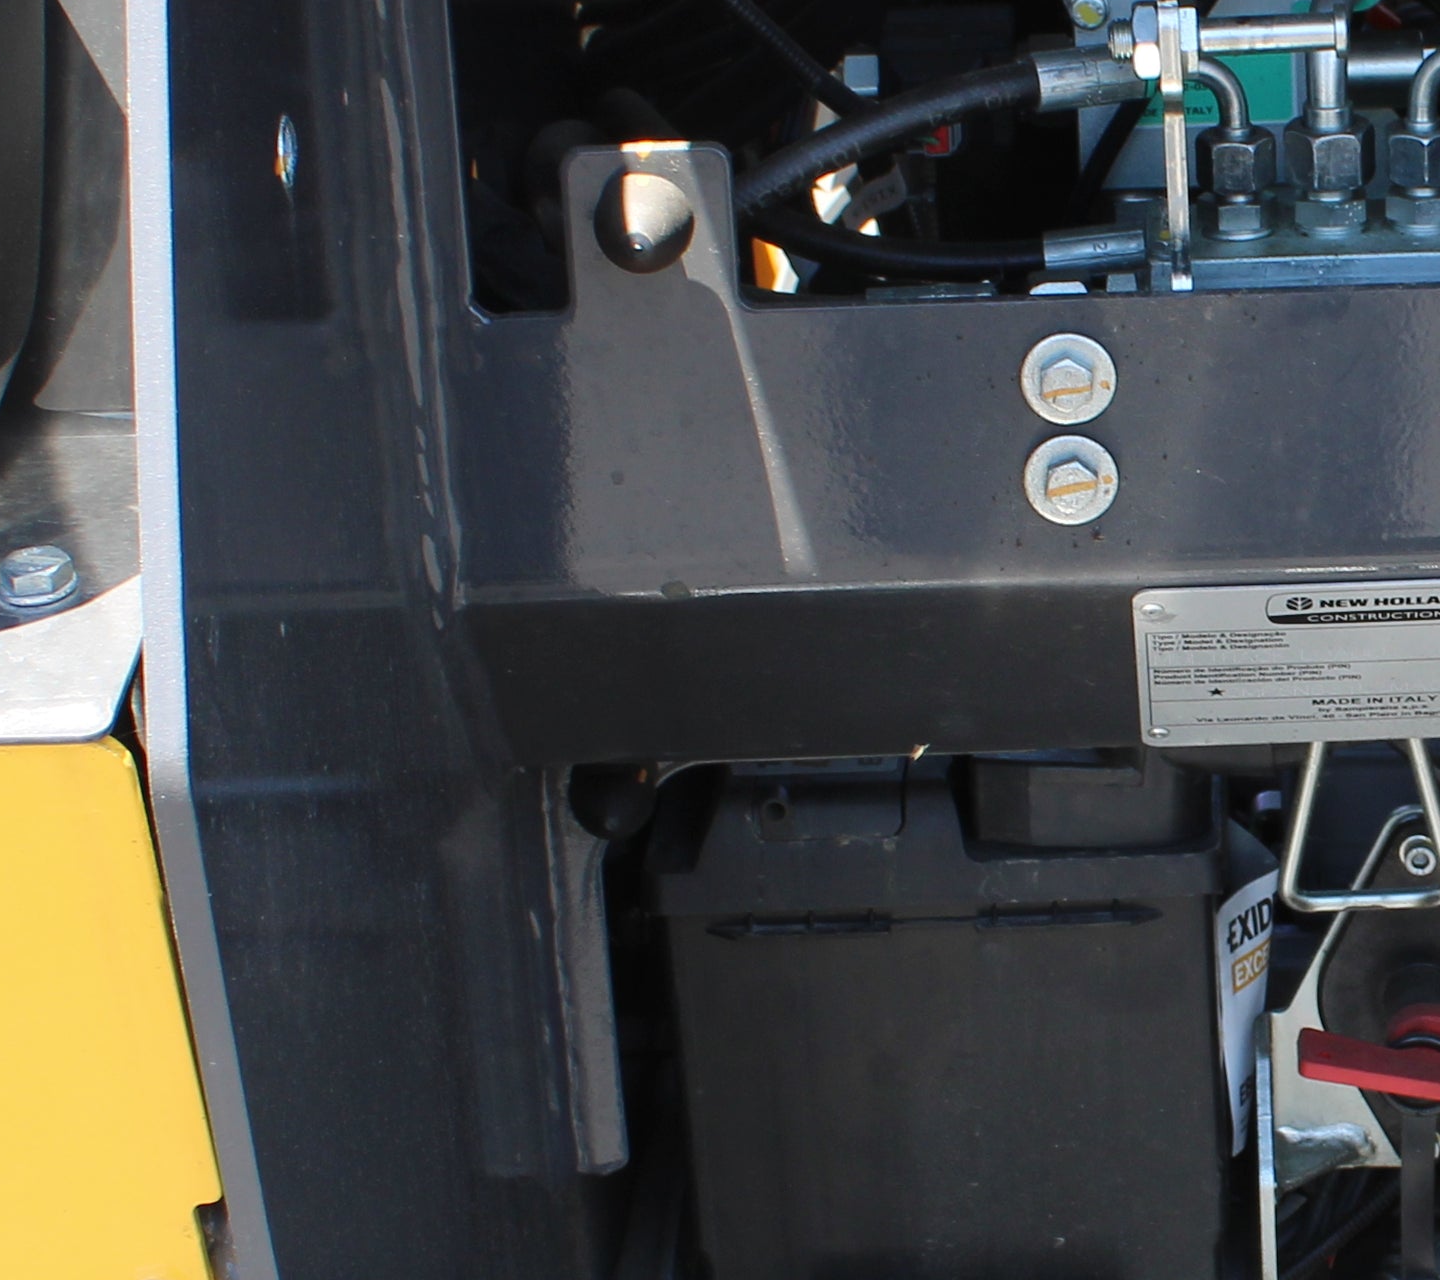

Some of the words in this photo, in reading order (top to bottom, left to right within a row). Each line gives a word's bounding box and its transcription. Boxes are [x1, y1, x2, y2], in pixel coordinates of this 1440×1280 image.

[1186, 106, 1213, 115] TALY
[1320, 598, 1368, 608] NEW
[1312, 698, 1361, 706] MADE
[1366, 696, 1383, 704] IN
[1389, 695, 1438, 703] ITALY
